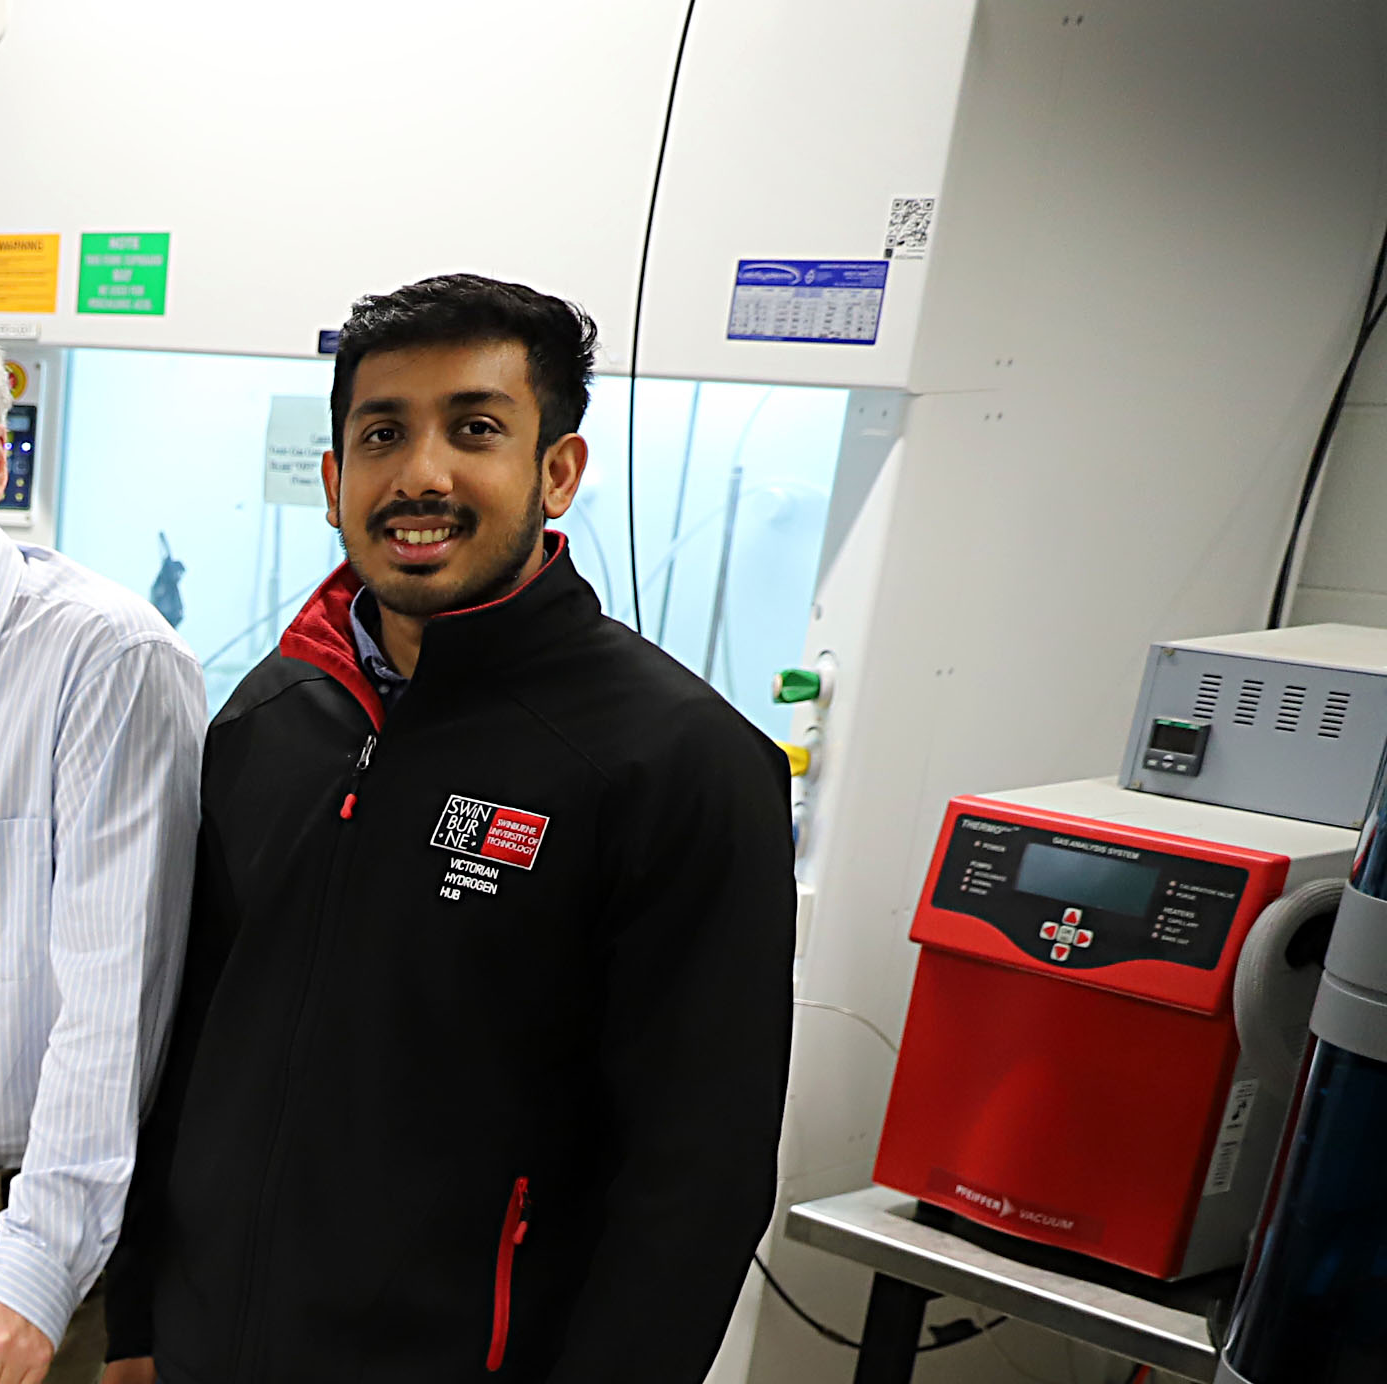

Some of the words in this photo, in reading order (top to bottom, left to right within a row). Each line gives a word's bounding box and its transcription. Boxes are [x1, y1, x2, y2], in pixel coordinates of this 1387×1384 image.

[447, 798, 492, 822] SWIN
[446, 814, 479, 836] BUR
[488, 826, 529, 845] UNIVERSITY
[527, 836, 540, 846] OF
[496, 818, 538, 836] SWINBURNE
[486, 836, 535, 855] TECHNOLOGY
[1052, 837, 1069, 846] GAS
[1070, 840, 1107, 854] ANALYSIS
[1107, 847, 1141, 860] SYSTEM
[450, 857, 500, 880] VICTORIAN
[439, 885, 462, 901] HUB
[444, 871, 499, 895] HYDROGEN
[1163, 907, 1196, 919] HEATERS
[955, 1184, 1002, 1211] PFEIFFER
[1019, 1208, 1075, 1230] VACUUM
